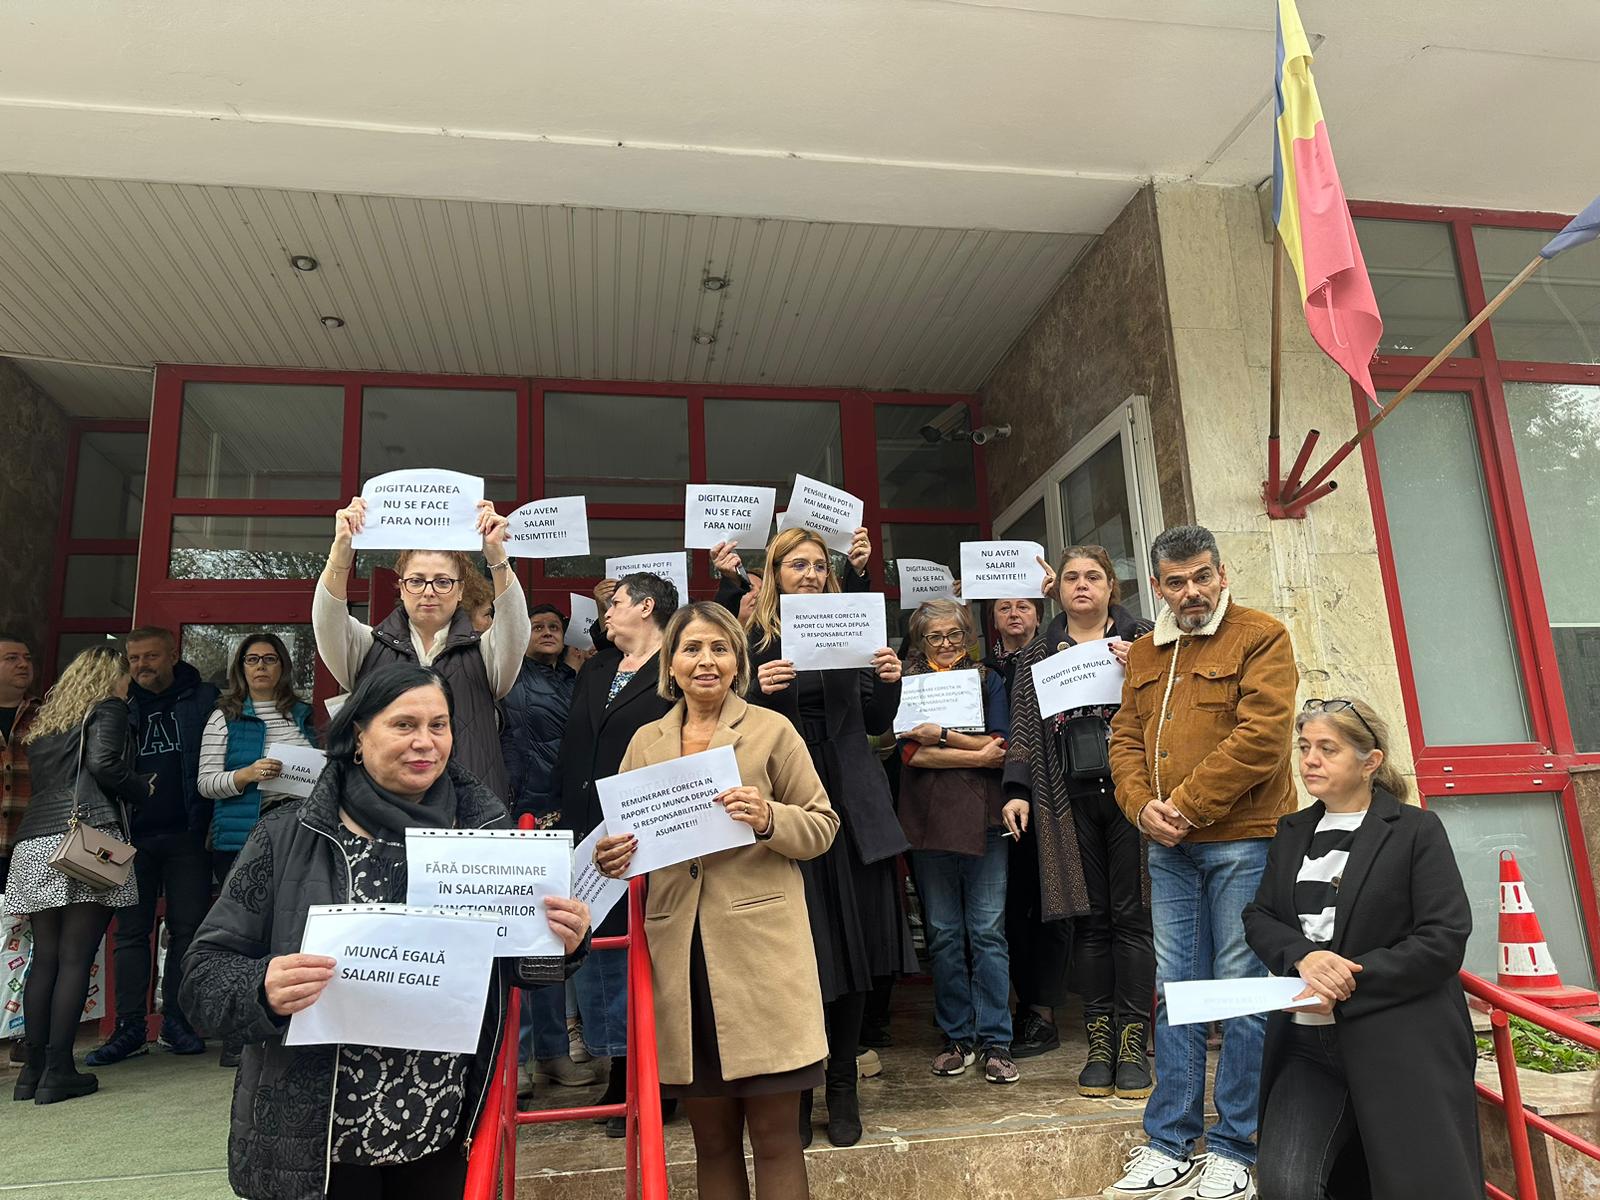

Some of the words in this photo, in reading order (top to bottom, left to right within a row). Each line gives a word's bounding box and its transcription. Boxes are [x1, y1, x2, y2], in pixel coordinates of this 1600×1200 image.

[375, 484, 460, 494] DIGITALIZAREA
[698, 494, 760, 504] DIGITALIZAREA
[804, 486, 826, 500] PENSIILE
[827, 494, 837, 503] NU
[837, 497, 848, 507] POT
[383, 500, 400, 509] NU
[404, 500, 418, 510] SE
[420, 500, 448, 510] FACE
[520, 508, 532, 516] NU
[534, 506, 558, 515] AVEM
[804, 498, 816, 506] MAI
[816, 501, 832, 512] MARI
[832, 506, 850, 518] DECAT
[705, 508, 718, 516] NU
[720, 508, 730, 516] SE
[732, 509, 752, 517] FACE
[811, 510, 839, 524] SALARIILE
[380, 516, 412, 526] FARA
[414, 516, 450, 526] NOI!!!
[524, 519, 555, 528] SALARII
[704, 522, 725, 530] FARA
[728, 522, 752, 531] NOI!!!
[804, 520, 839, 535] NOASTRE!!!
[514, 530, 567, 541] NESIMTITE!!!
[976, 573, 1026, 581] NESIMTITE!!!
[1042, 668, 1071, 685] CONDITII
[1082, 659, 1112, 669] MUNCA
[1060, 672, 1096, 686] ADECVATE
[291, 764, 311, 774] FARA
[280, 772, 316, 784] CRIMINAR
[621, 787, 671, 808] REMUNERARE
[671, 780, 704, 793] CORECTA
[704, 777, 713, 785] IN
[621, 806, 650, 821] RAPORT
[651, 803, 662, 812] CU
[662, 795, 690, 808] MUNCA
[691, 788, 719, 801] DEPUSA
[633, 822, 640, 830] SI
[641, 802, 712, 828] RESPONSABILITATILE
[655, 819, 698, 837] ASUMATE!!!
[425, 861, 458, 874] FĂRĂ
[461, 864, 547, 876] DISCRIMINARE
[438, 882, 453, 894] ÎN
[455, 884, 534, 896] SALARIZAREA
[344, 946, 398, 960] MUNCĂ
[402, 950, 446, 964] EGALĂ
[340, 967, 394, 983] SALARII
[398, 972, 440, 987] EGALE
